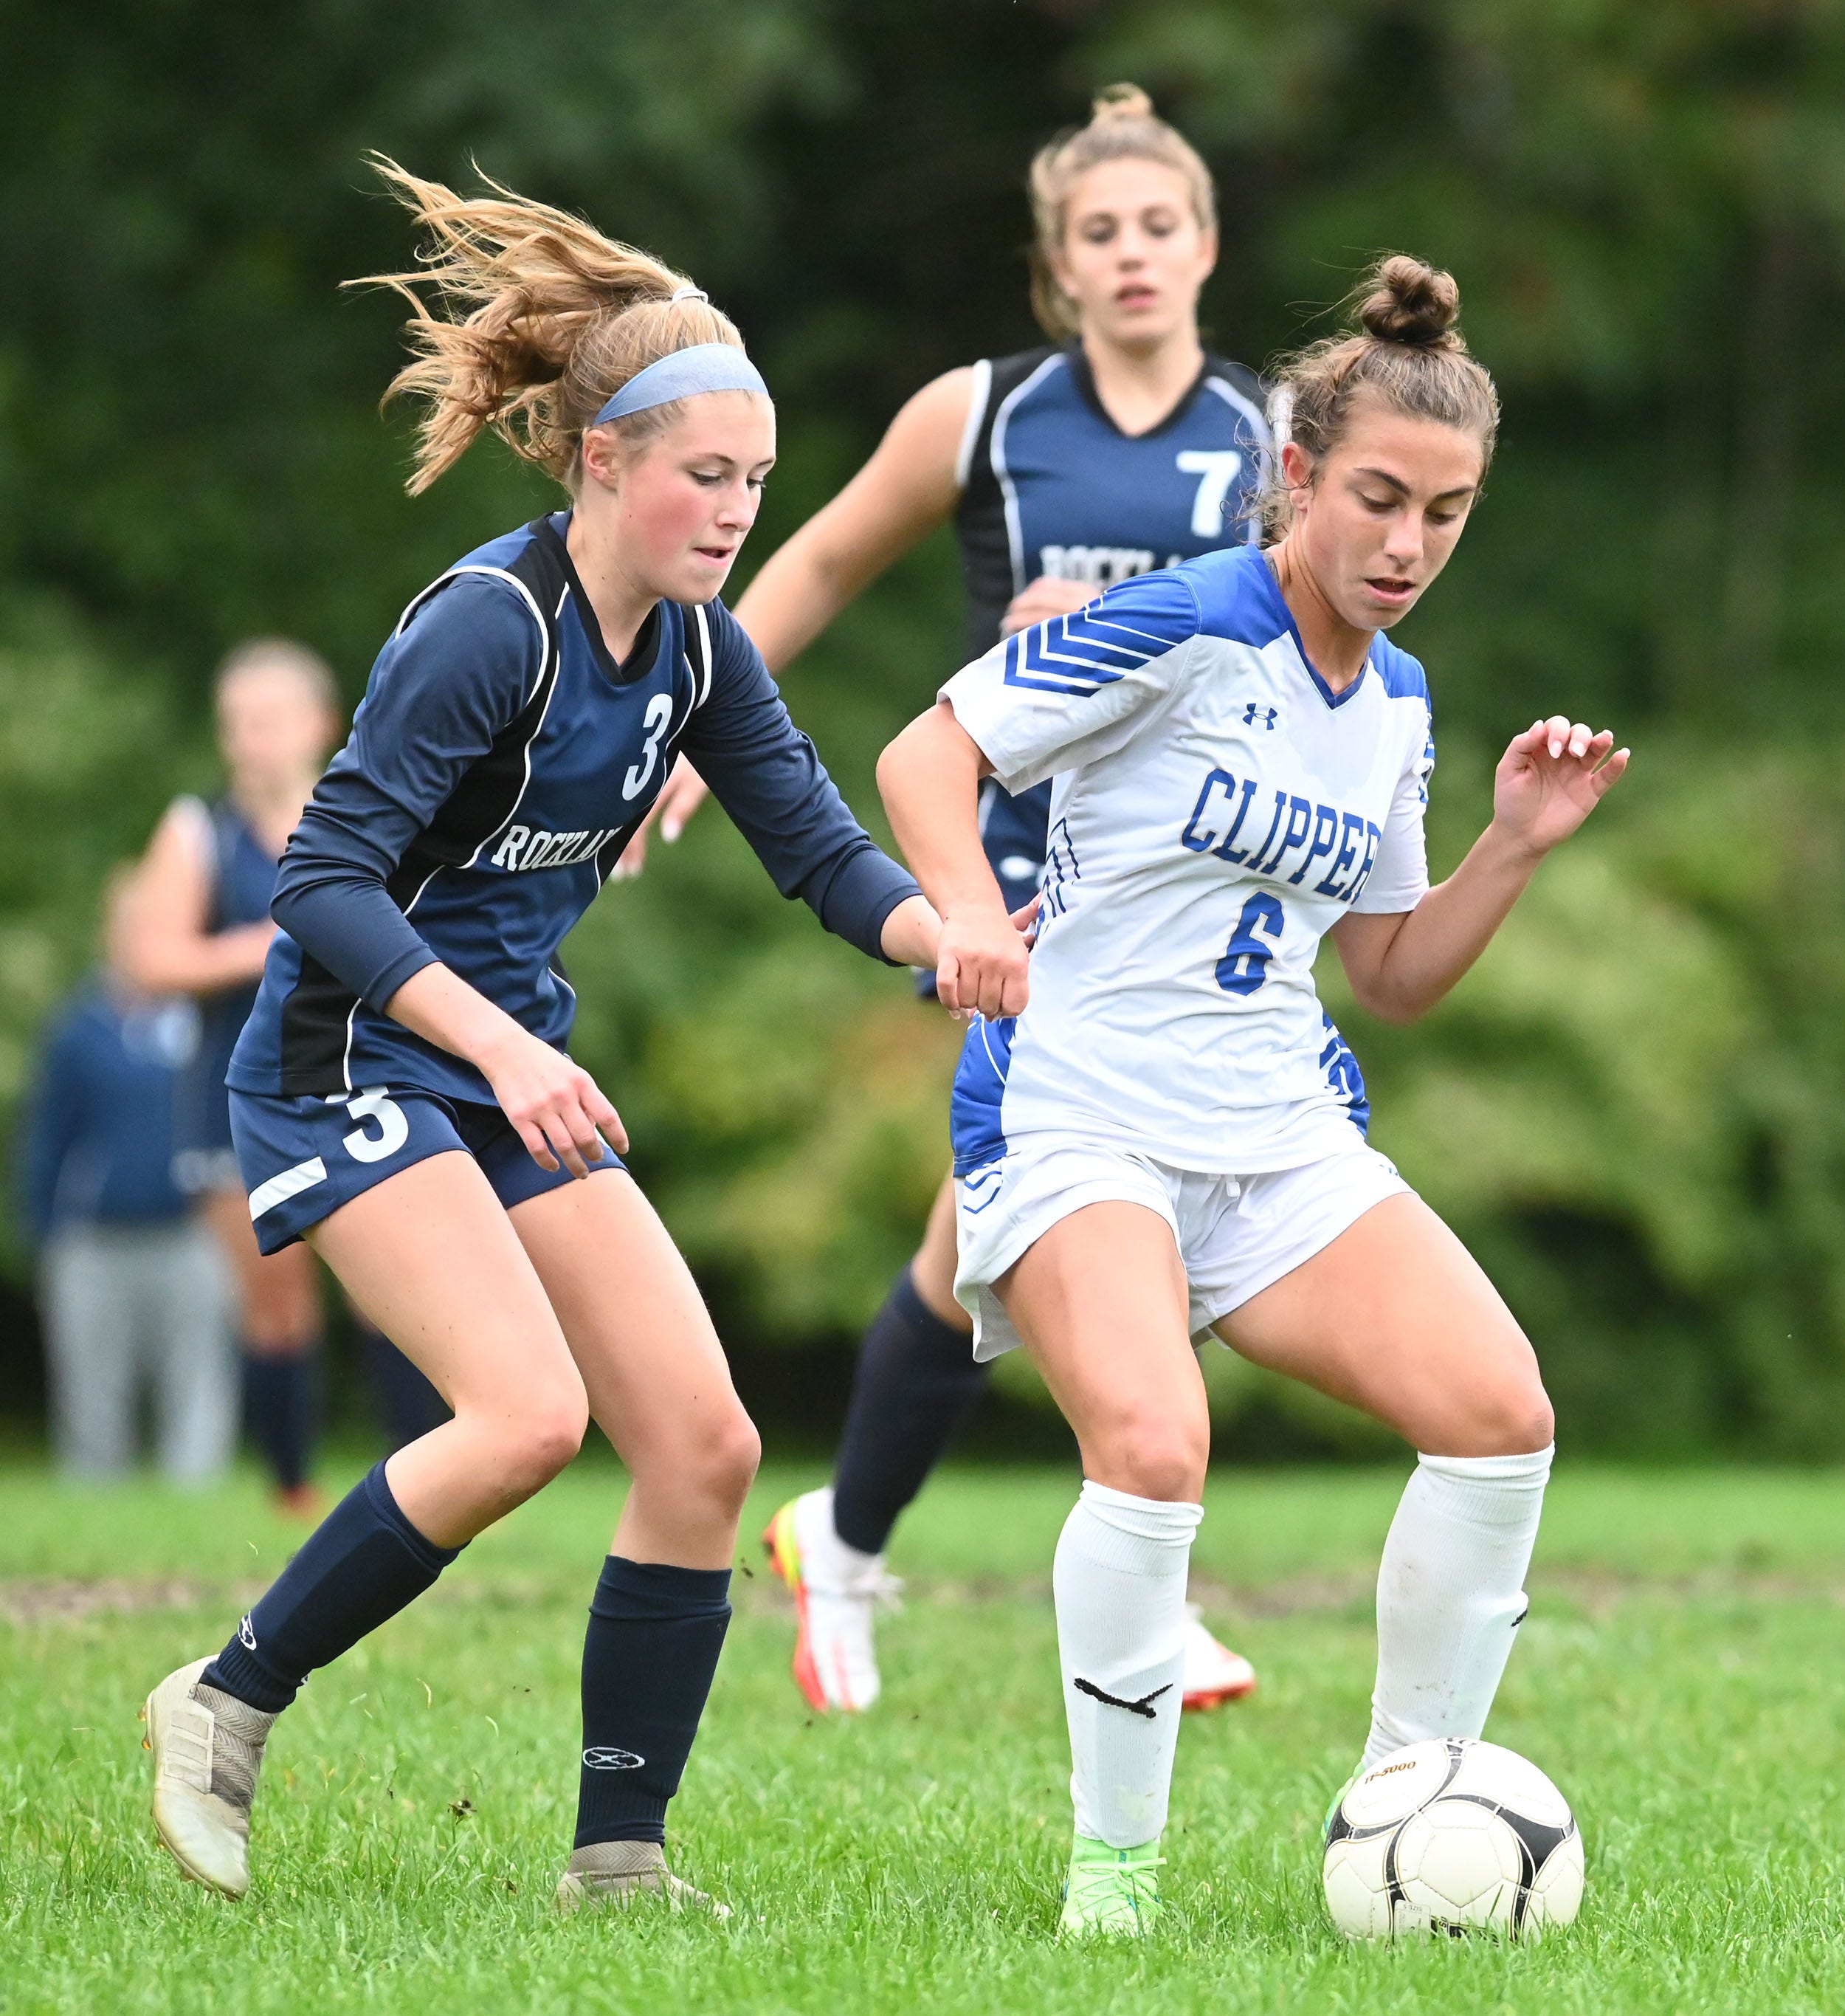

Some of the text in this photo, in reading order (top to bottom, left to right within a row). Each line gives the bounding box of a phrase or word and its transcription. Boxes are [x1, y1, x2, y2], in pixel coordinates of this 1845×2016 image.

[1176, 450, 1241, 538] 7
[1040, 544, 1182, 588] ROCKL
[622, 693, 672, 800] 3
[1214, 891, 1285, 997] 6
